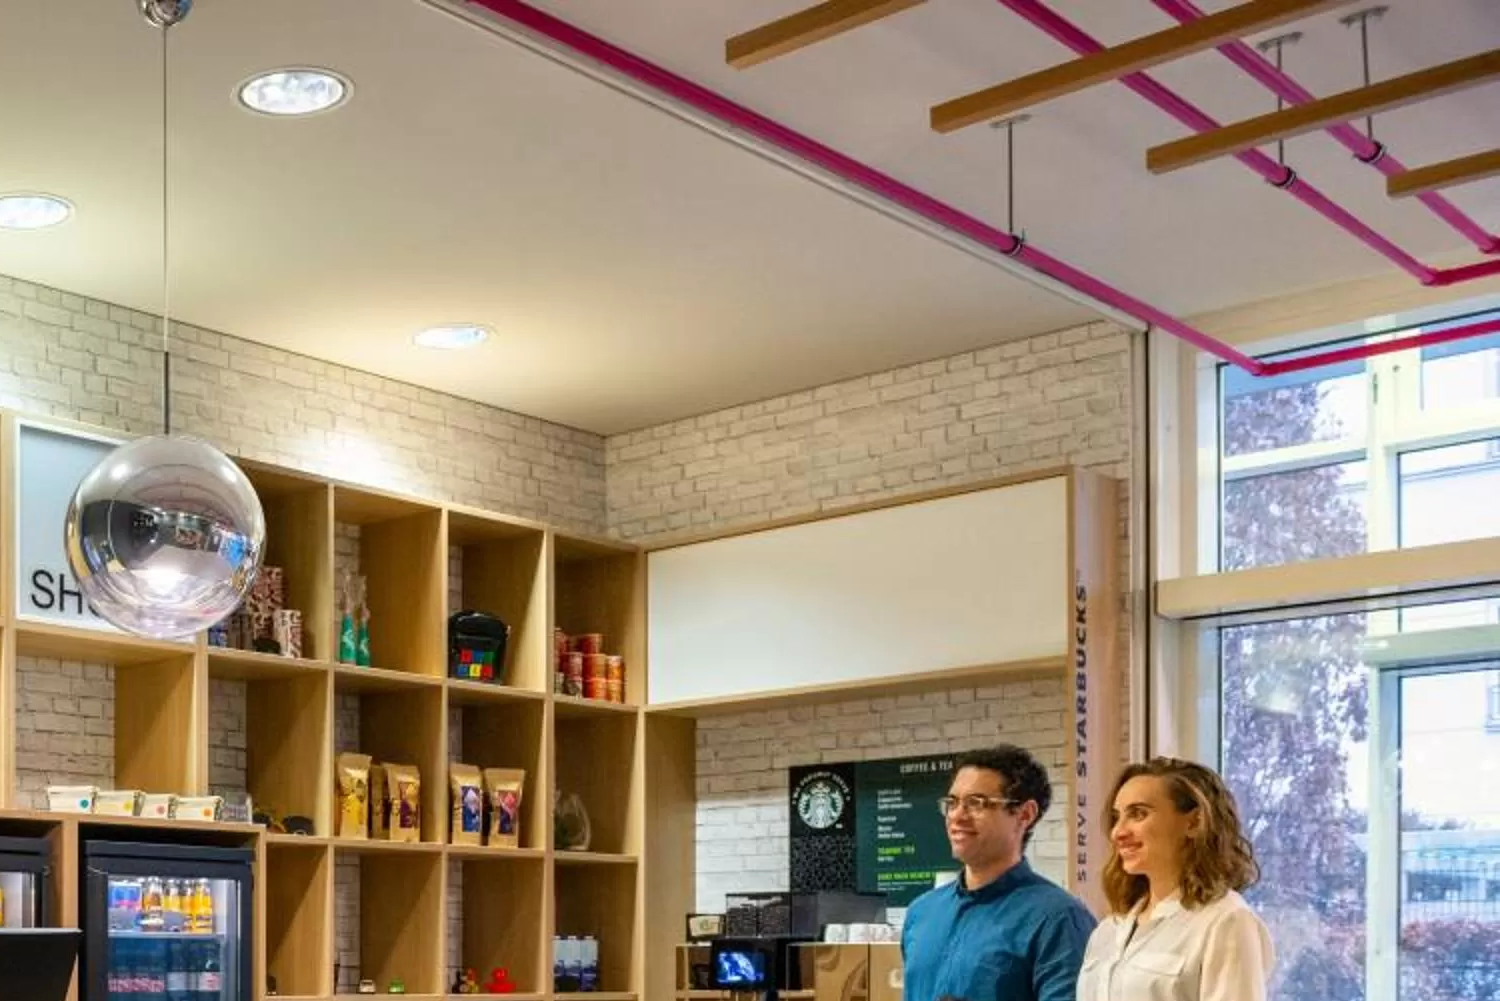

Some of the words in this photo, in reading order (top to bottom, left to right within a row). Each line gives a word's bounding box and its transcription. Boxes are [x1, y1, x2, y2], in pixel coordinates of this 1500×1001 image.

[31, 569, 100, 618] SH
[1075, 585, 1088, 779] STARBUCKS
[1076, 794, 1088, 883] SERVE
